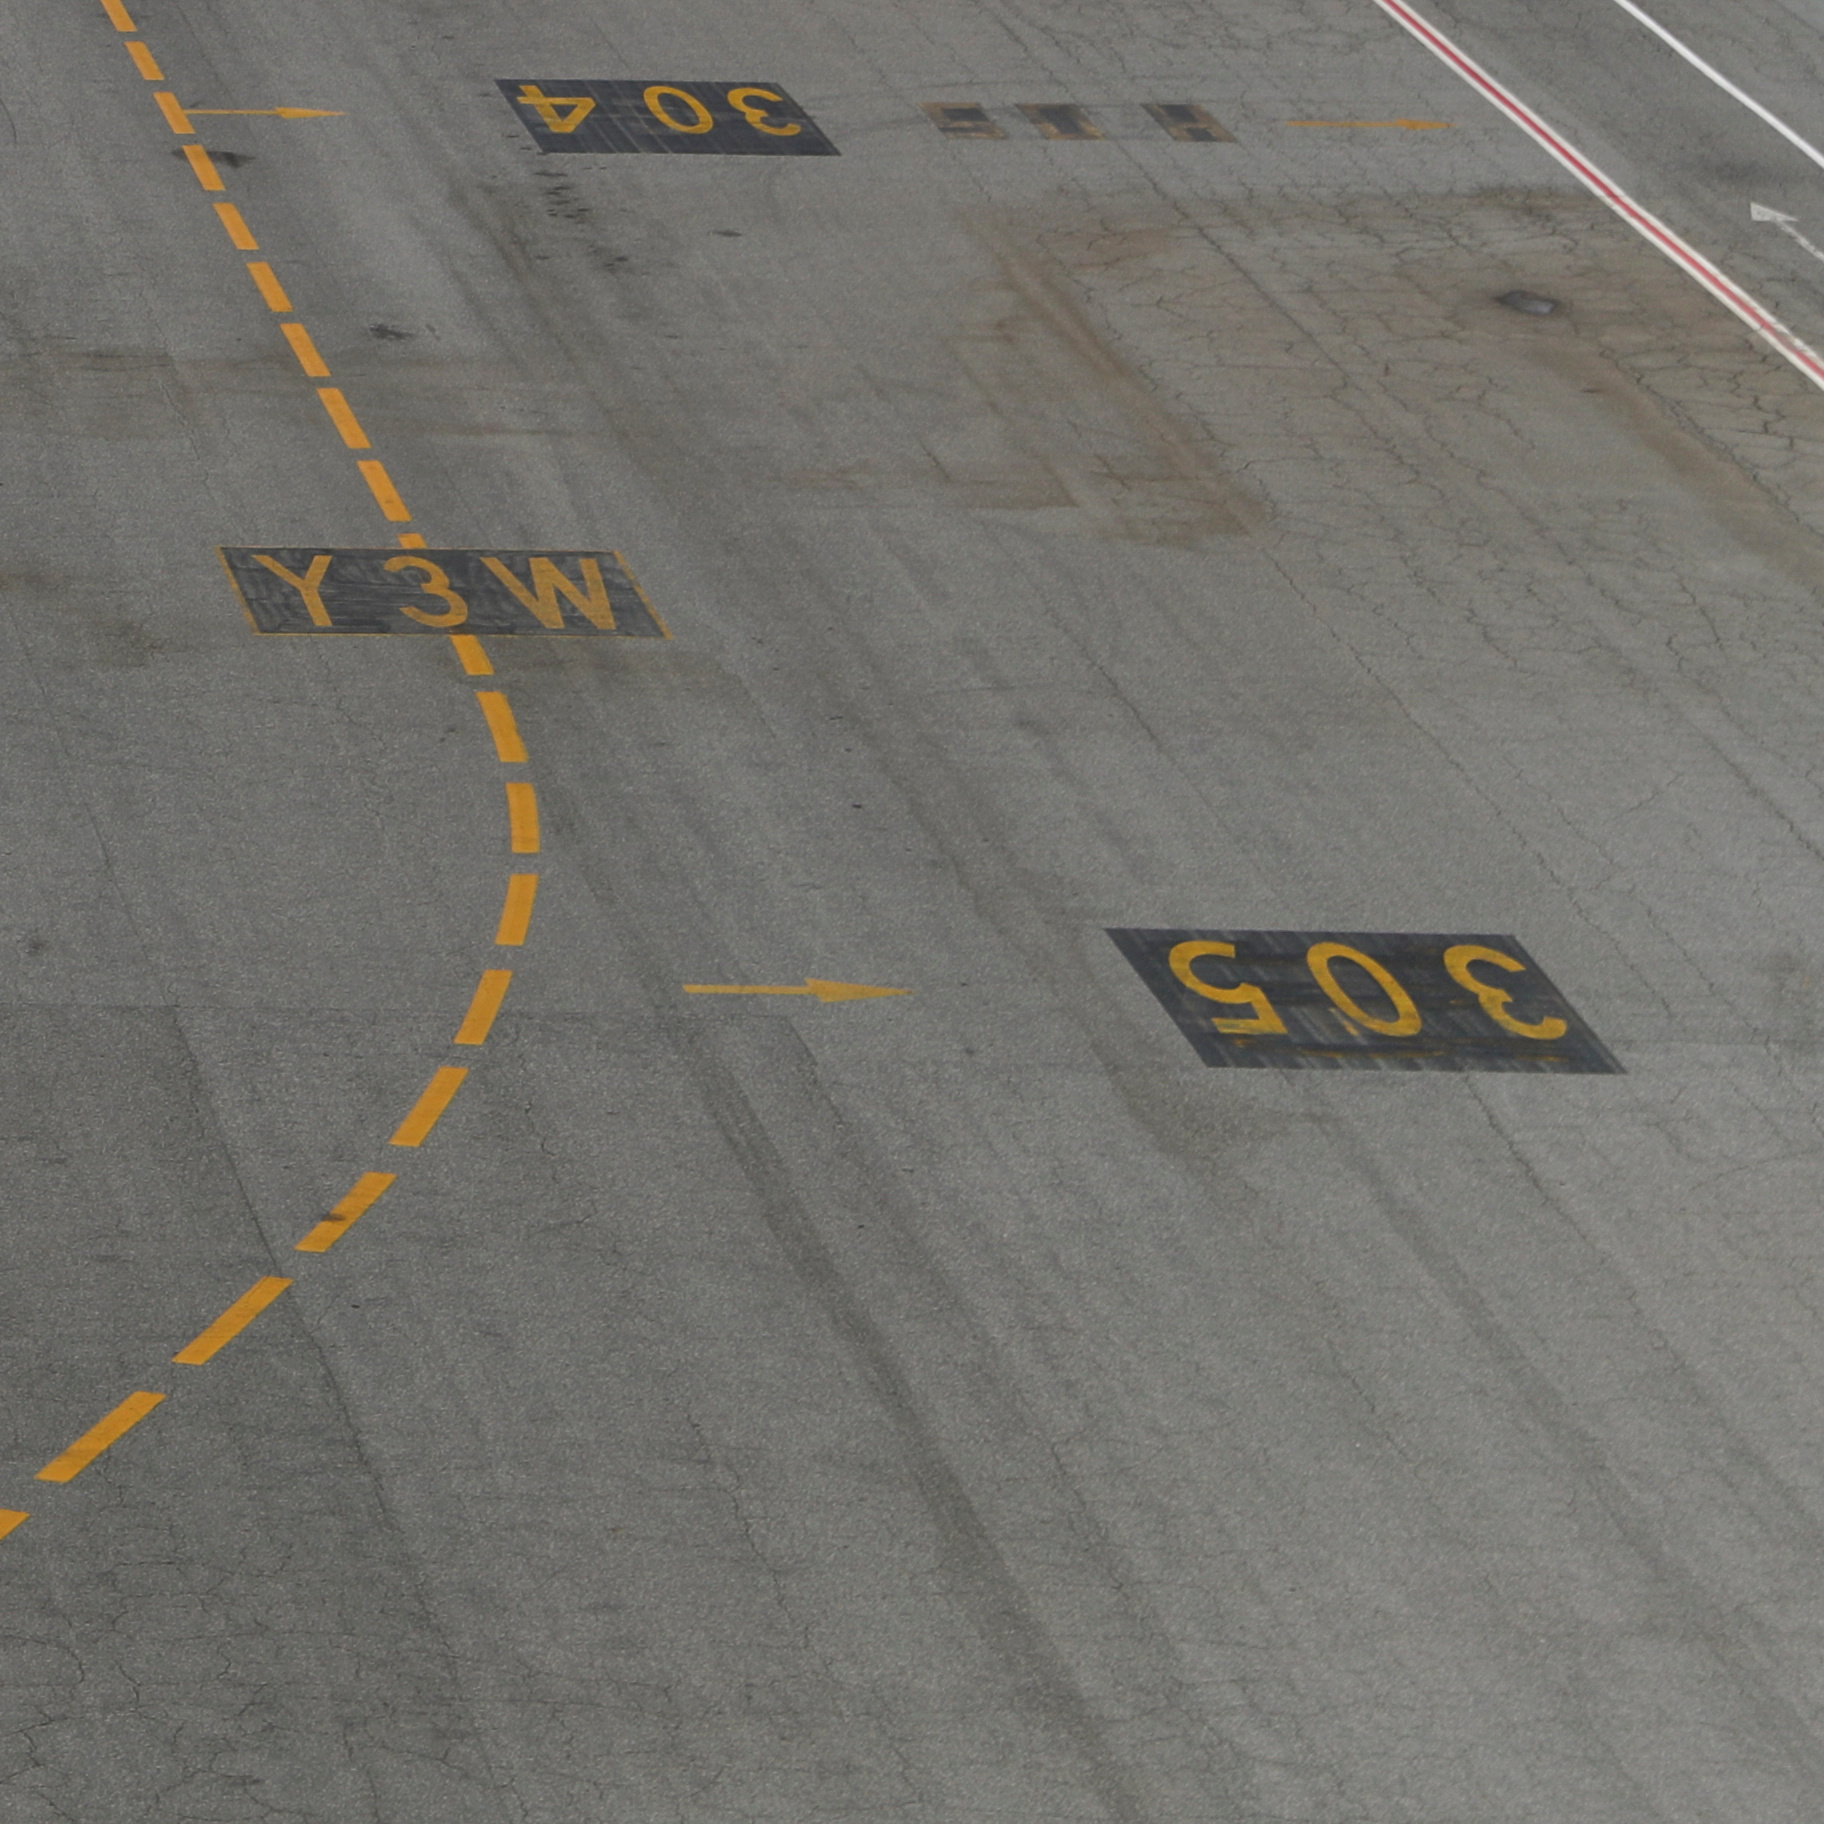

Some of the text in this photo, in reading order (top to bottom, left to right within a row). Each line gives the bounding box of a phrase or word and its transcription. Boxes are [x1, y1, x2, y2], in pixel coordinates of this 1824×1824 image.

[516, 84, 805, 139] 304
[252, 553, 619, 632] Y3W
[1167, 939, 1571, 1045] 305
